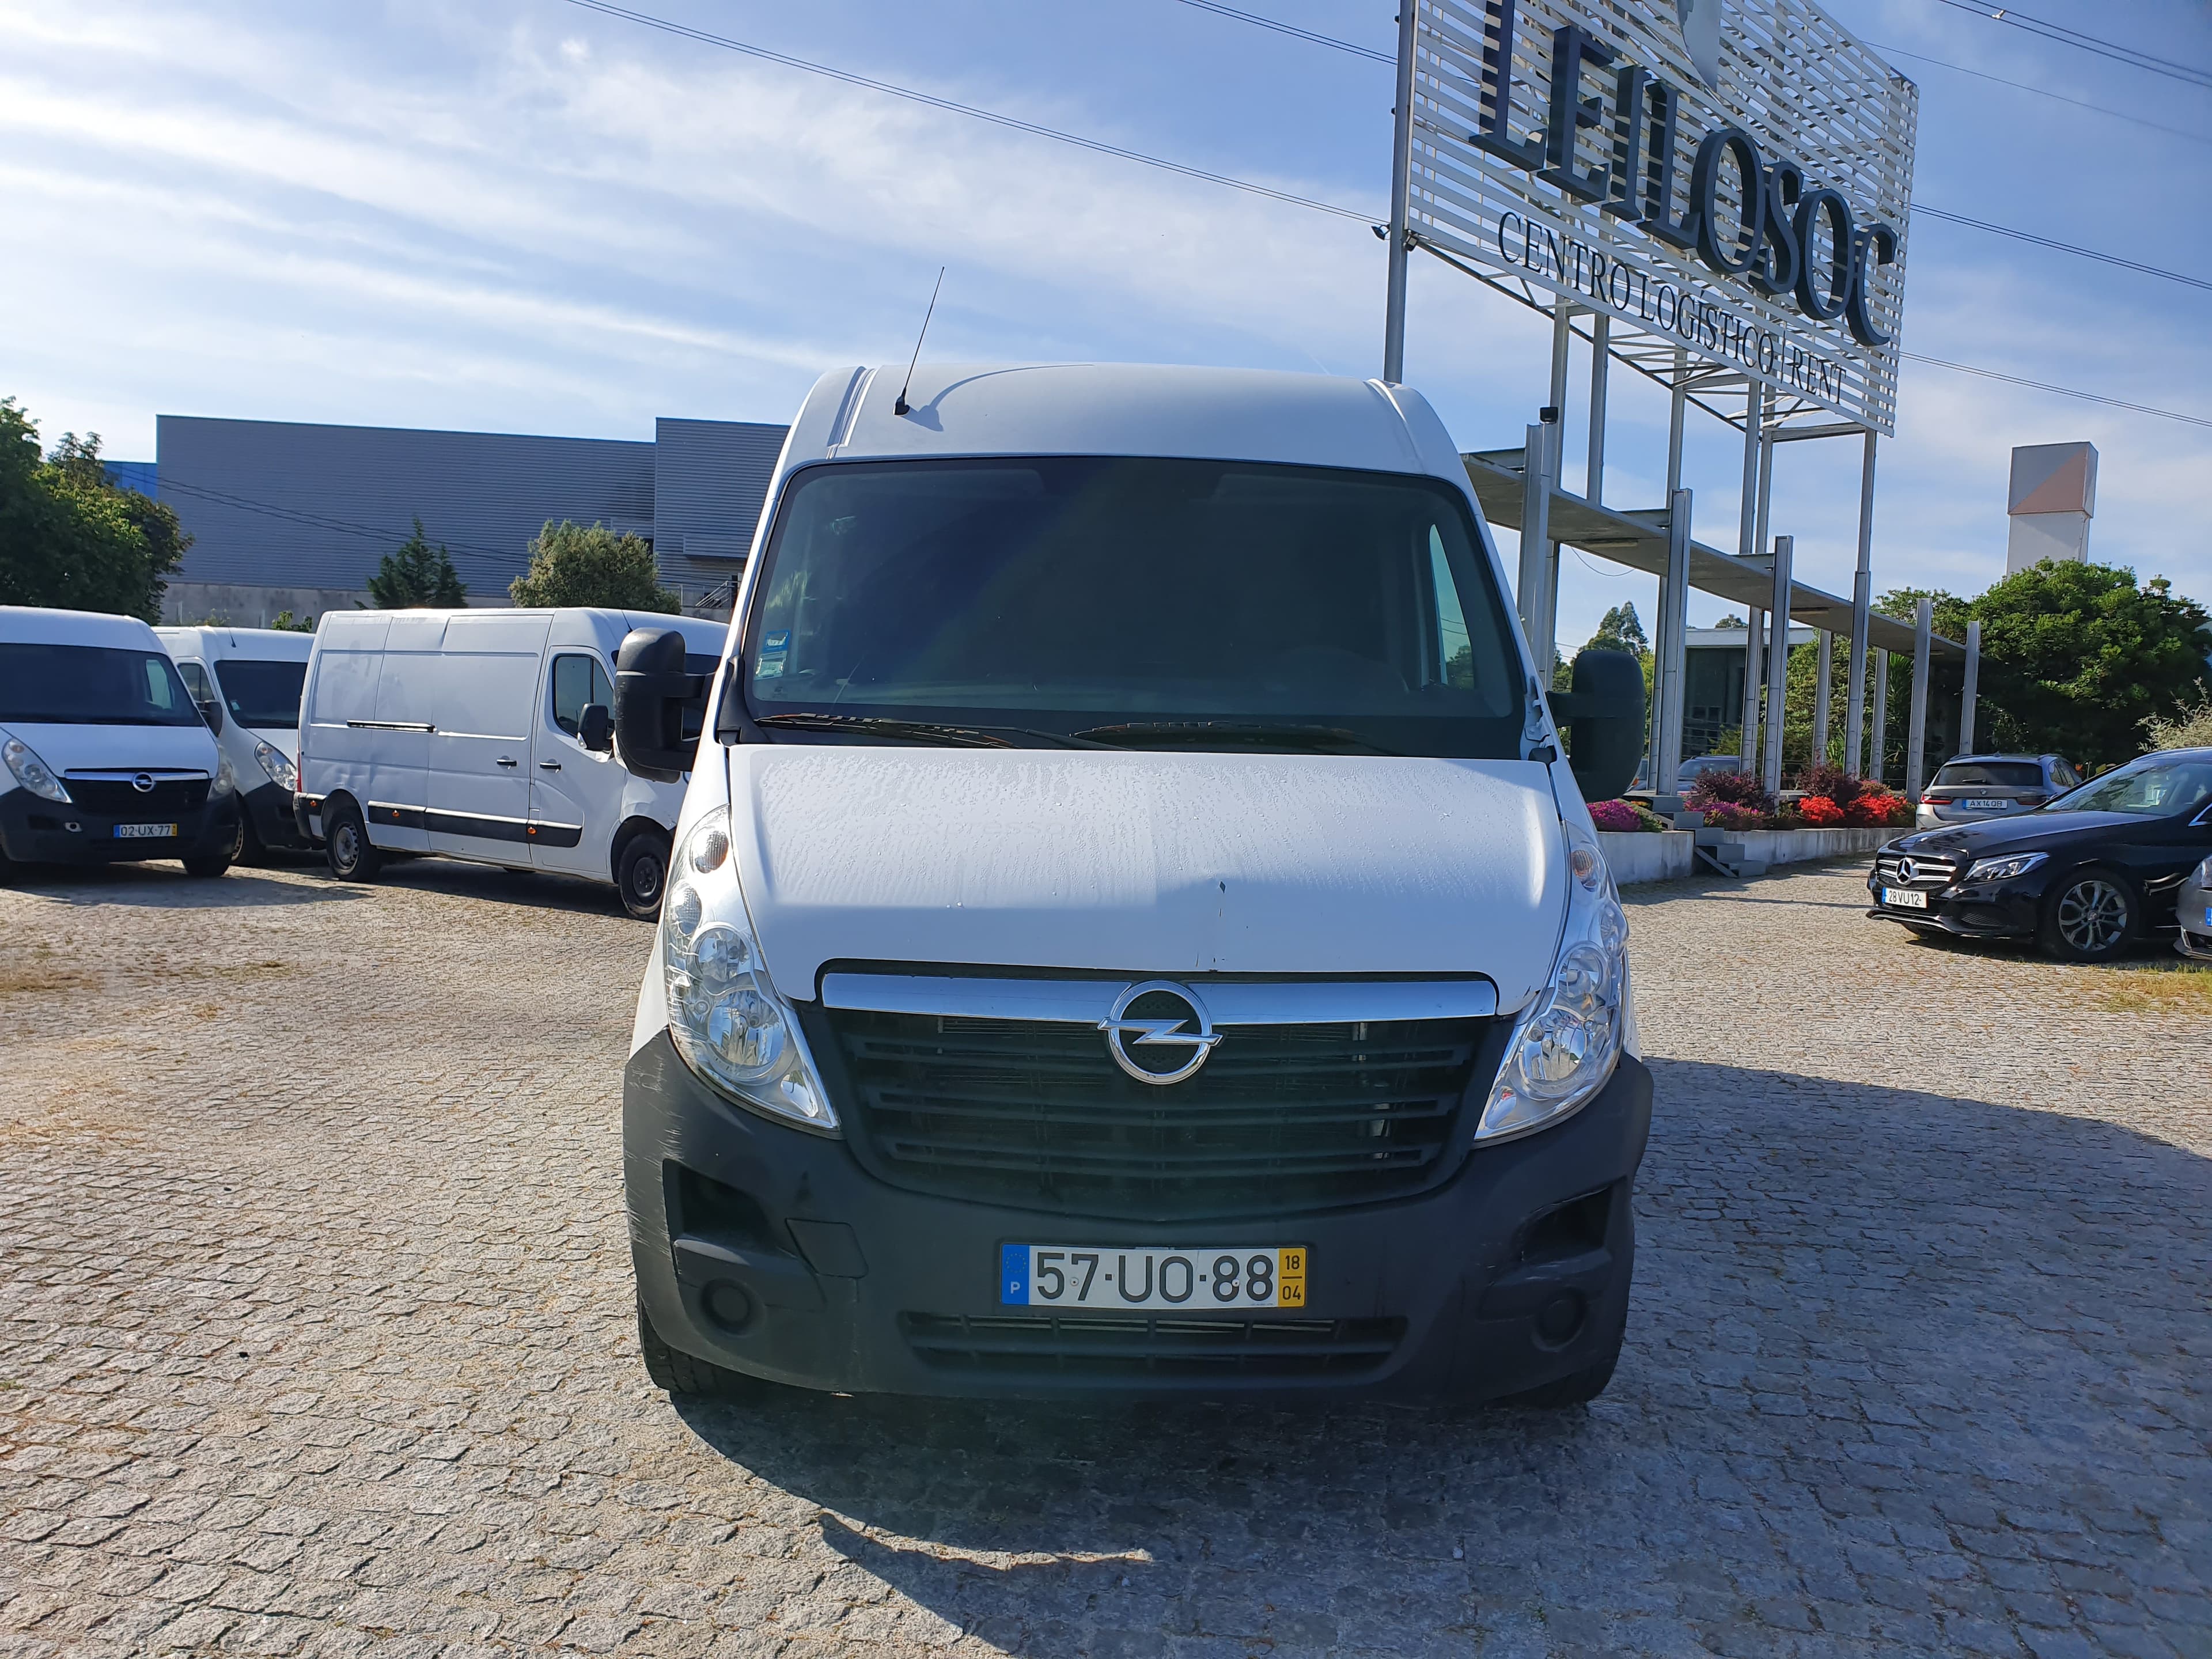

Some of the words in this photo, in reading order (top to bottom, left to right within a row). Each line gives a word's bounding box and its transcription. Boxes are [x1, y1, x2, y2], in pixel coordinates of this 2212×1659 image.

[1469, 0, 1897, 346] LEILOSOC
[1498, 211, 1630, 310] CENTRO
[1639, 274, 1774, 374] LOGÍSTICO
[1790, 346, 1846, 404] RENT
[1285, 1255, 1300, 1270] 18
[1010, 1281, 1020, 1294] P
[1282, 1285, 1301, 1300] 04
